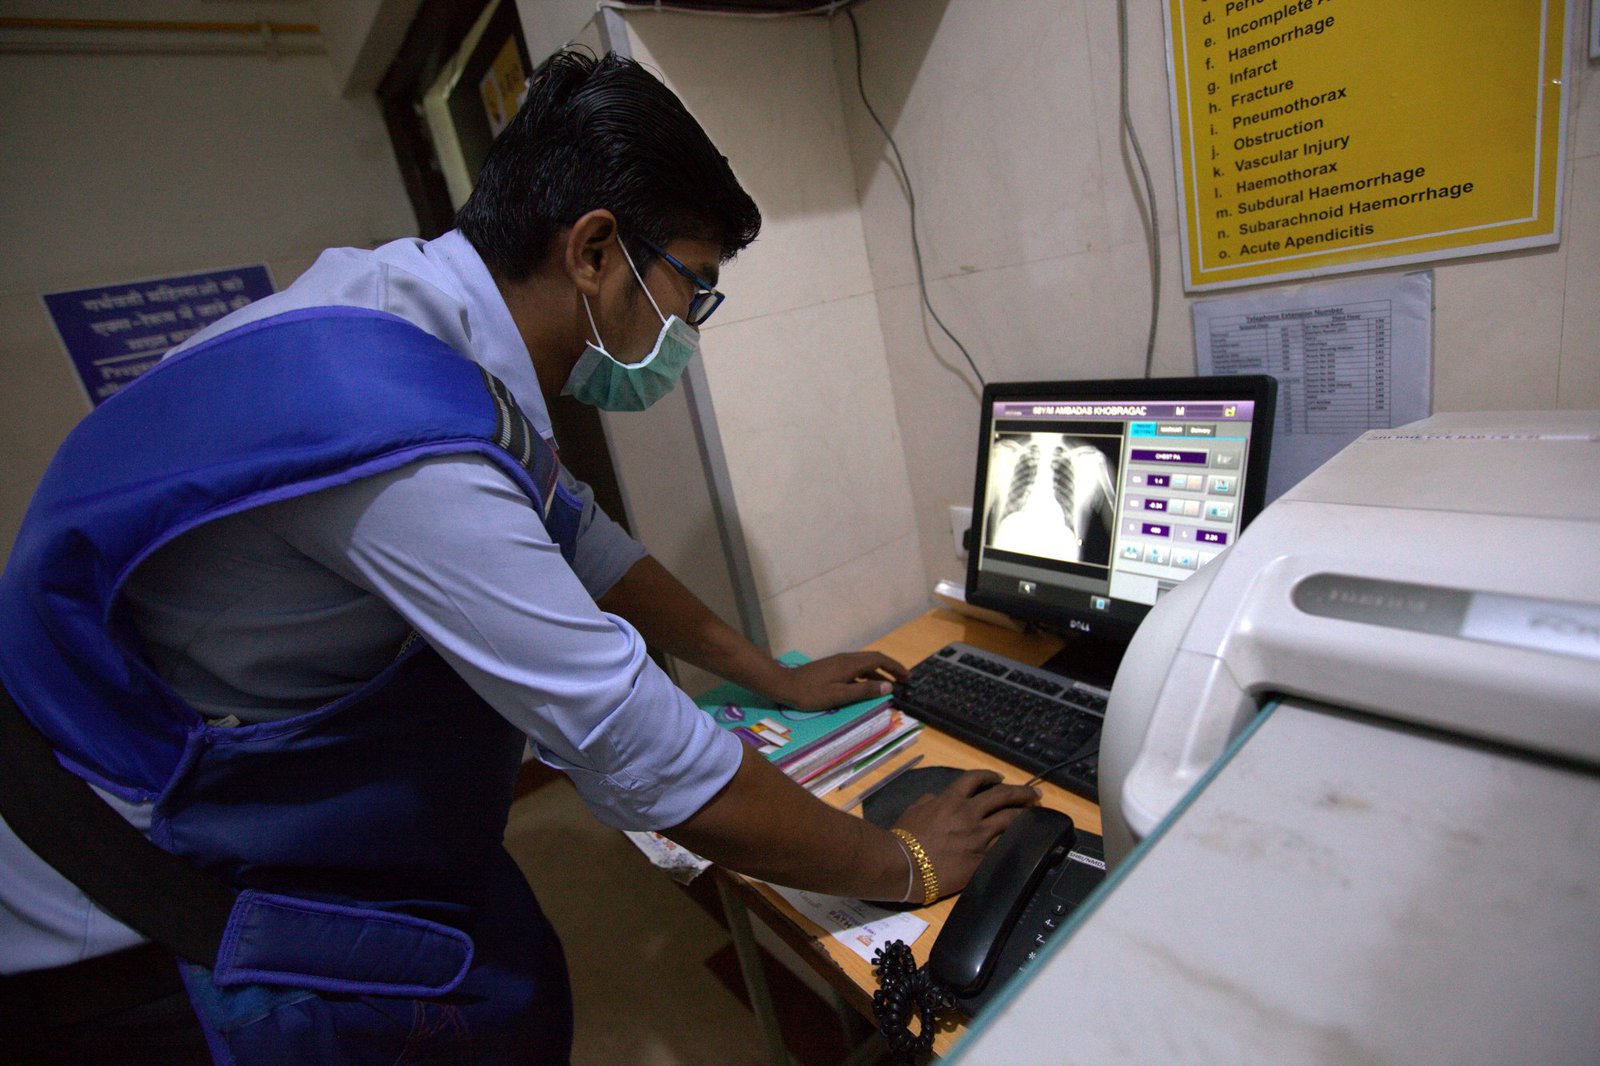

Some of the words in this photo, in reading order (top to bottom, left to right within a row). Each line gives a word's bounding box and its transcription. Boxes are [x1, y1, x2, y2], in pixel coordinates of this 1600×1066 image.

[1202, 11, 1215, 25] d.
[1204, 38, 1216, 48] e.
[1227, 0, 1313, 39] Incomplete
[1205, 57, 1214, 70] f.
[1228, 16, 1335, 62] Haemorrhage
[1207, 82, 1220, 95] g.
[1230, 58, 1278, 85] Infarct
[1208, 102, 1222, 114] h.
[1231, 79, 1295, 107] Fracture
[1210, 124, 1218, 136] i.
[1232, 87, 1347, 129] Pneumothorax
[1212, 145, 1220, 160] j.
[1233, 118, 1324, 151] Obstruction
[1213, 166, 1225, 178] k.
[1235, 148, 1299, 172] Vascular
[1303, 135, 1350, 156] Injury
[1216, 208, 1232, 219] m.
[1238, 190, 1303, 214] Subdural
[1309, 166, 1426, 200] Haemorrhage
[1236, 162, 1338, 193] Haemothorax
[1217, 230, 1230, 239] n.
[1239, 204, 1344, 235] Subarachnoid
[1349, 182, 1474, 215] Haemorrhage
[1218, 250, 1231, 259] o.
[1240, 240, 1280, 256] Acute
[1284, 223, 1374, 249] Apendicitis
[1055, 406, 1092, 416] AMBADAS
